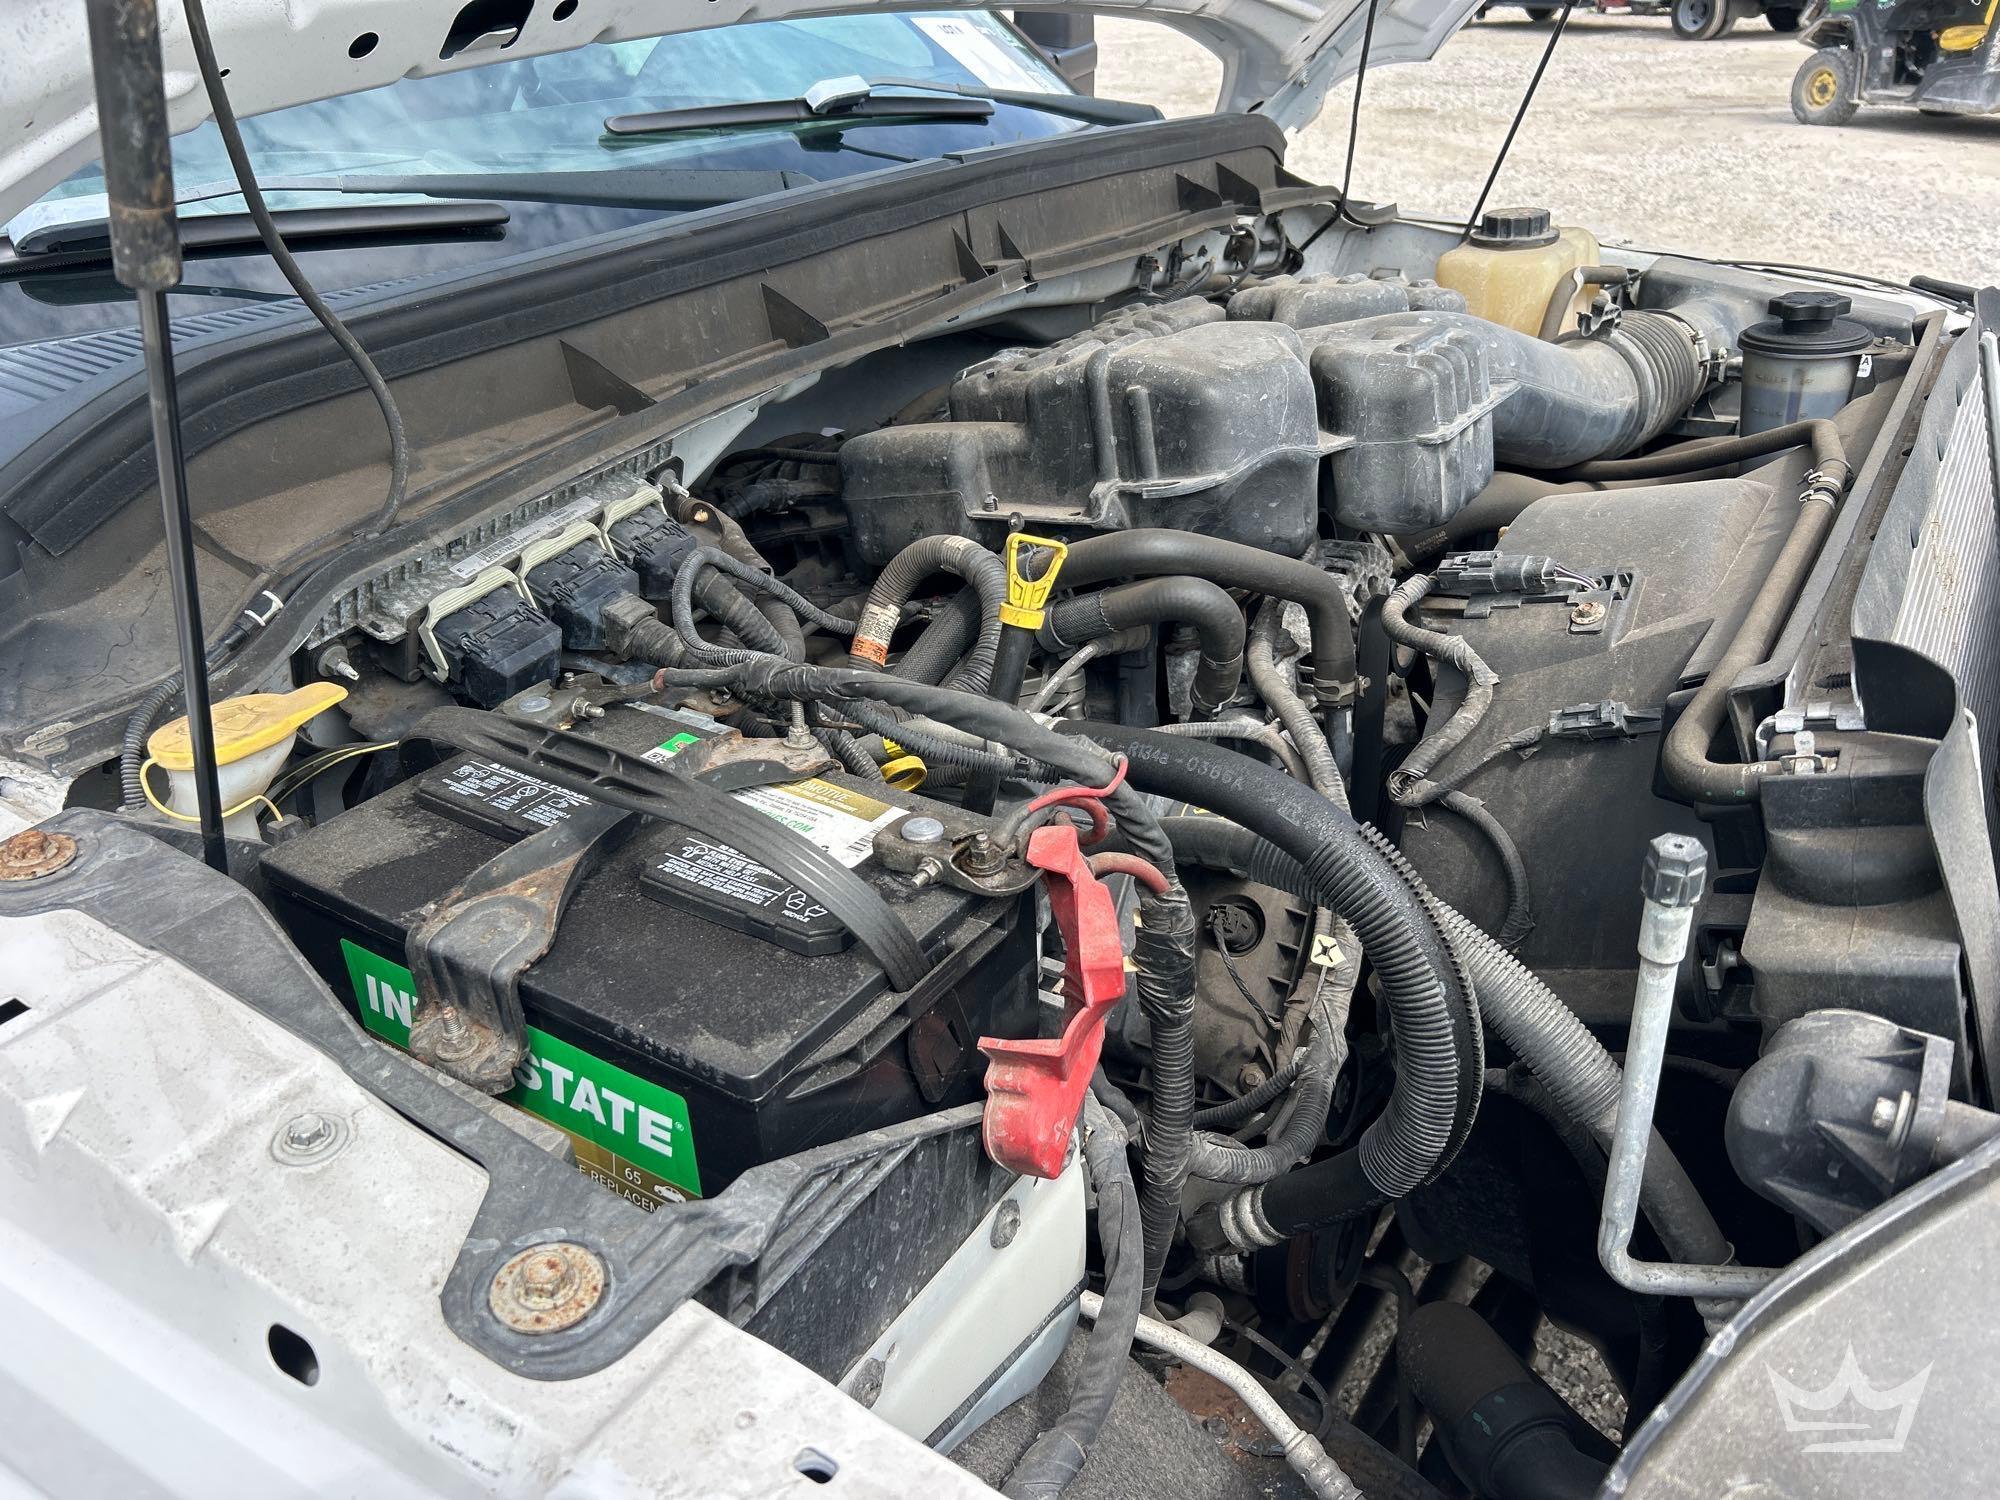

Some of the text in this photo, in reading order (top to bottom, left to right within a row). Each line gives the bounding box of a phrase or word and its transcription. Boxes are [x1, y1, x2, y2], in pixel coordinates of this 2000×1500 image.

[796, 779, 851, 802] OMOTIVE
[740, 873, 759, 883] FAST
[781, 909, 811, 923] RECYCLE
[625, 1168, 642, 1185] 65
[590, 1169, 661, 1213] REPLACEM
